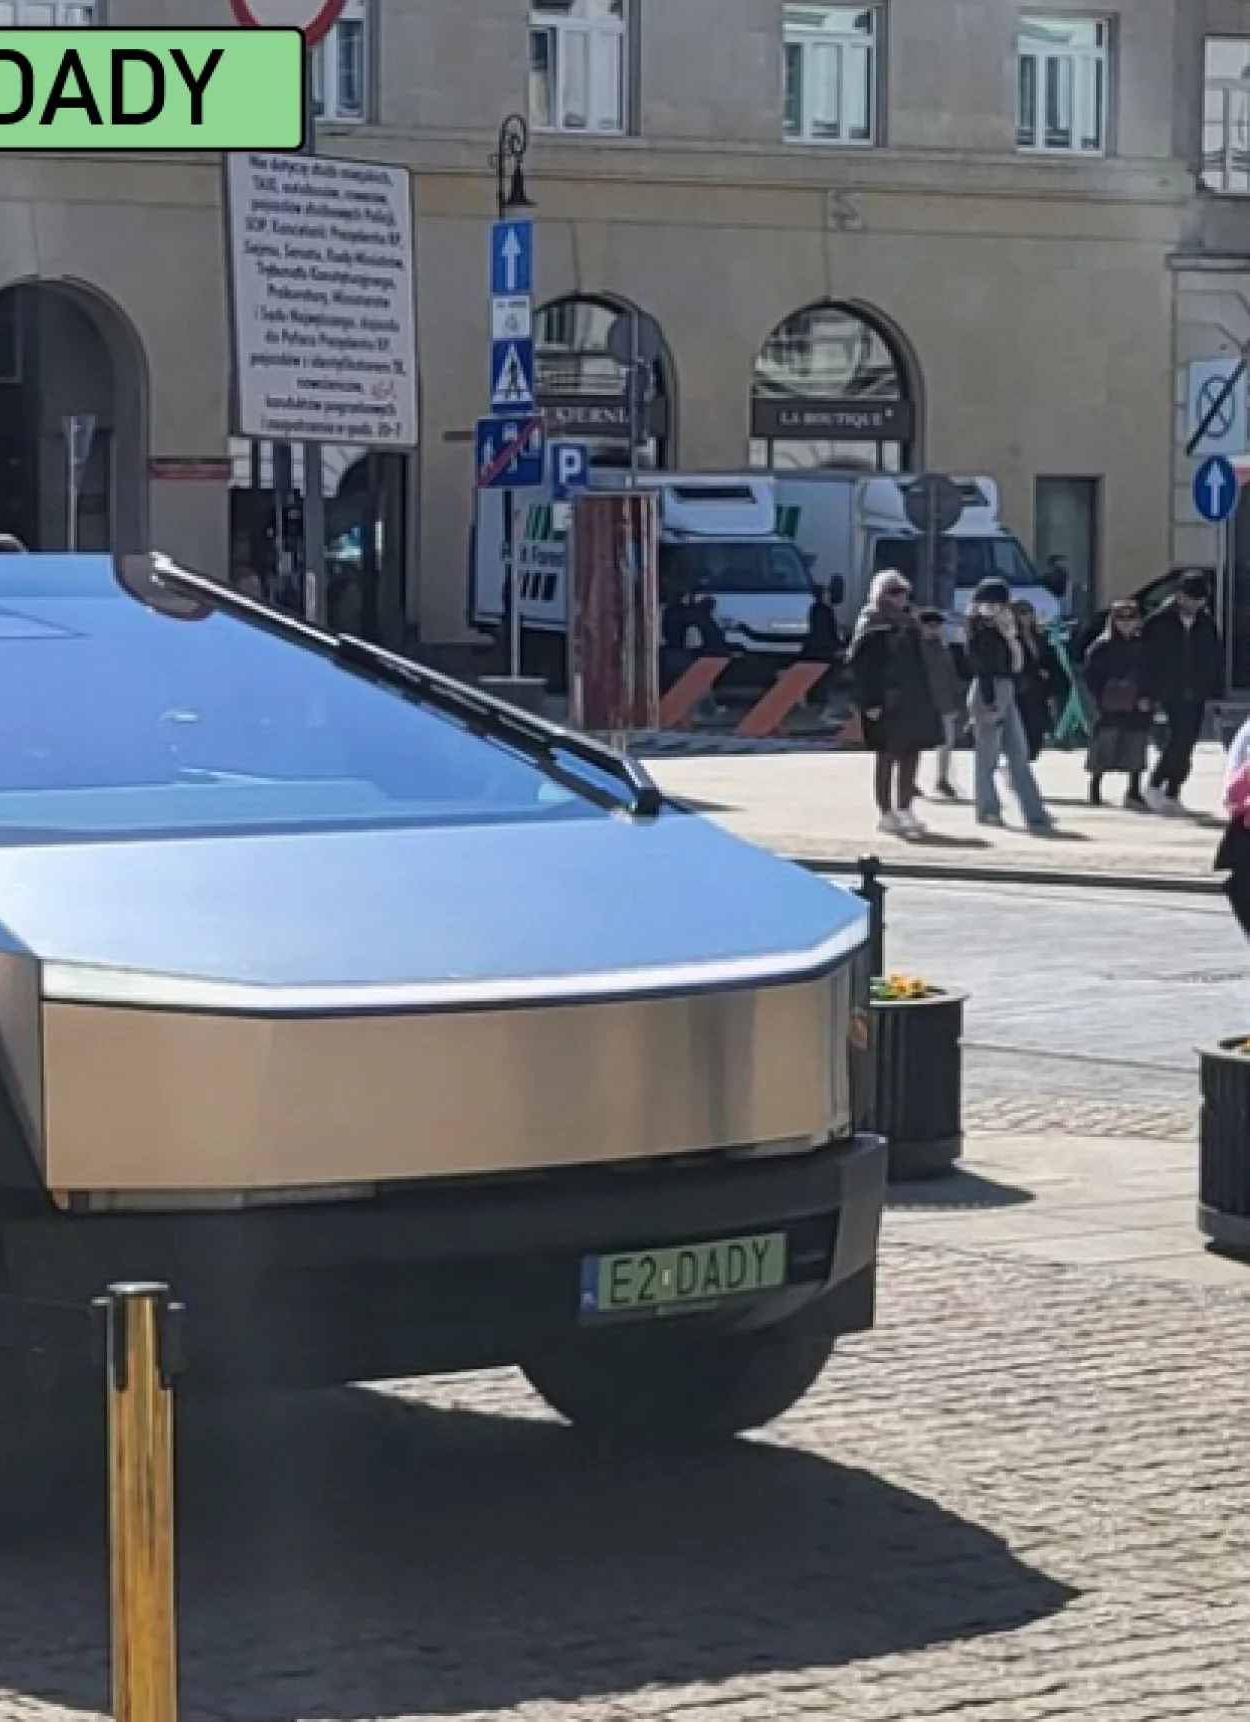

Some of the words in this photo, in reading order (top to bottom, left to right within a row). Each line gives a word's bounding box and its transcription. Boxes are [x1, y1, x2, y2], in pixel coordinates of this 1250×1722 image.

[558, 449, 582, 487] P
[610, 1256, 657, 1304] E2
[676, 1239, 771, 1296] DADY
